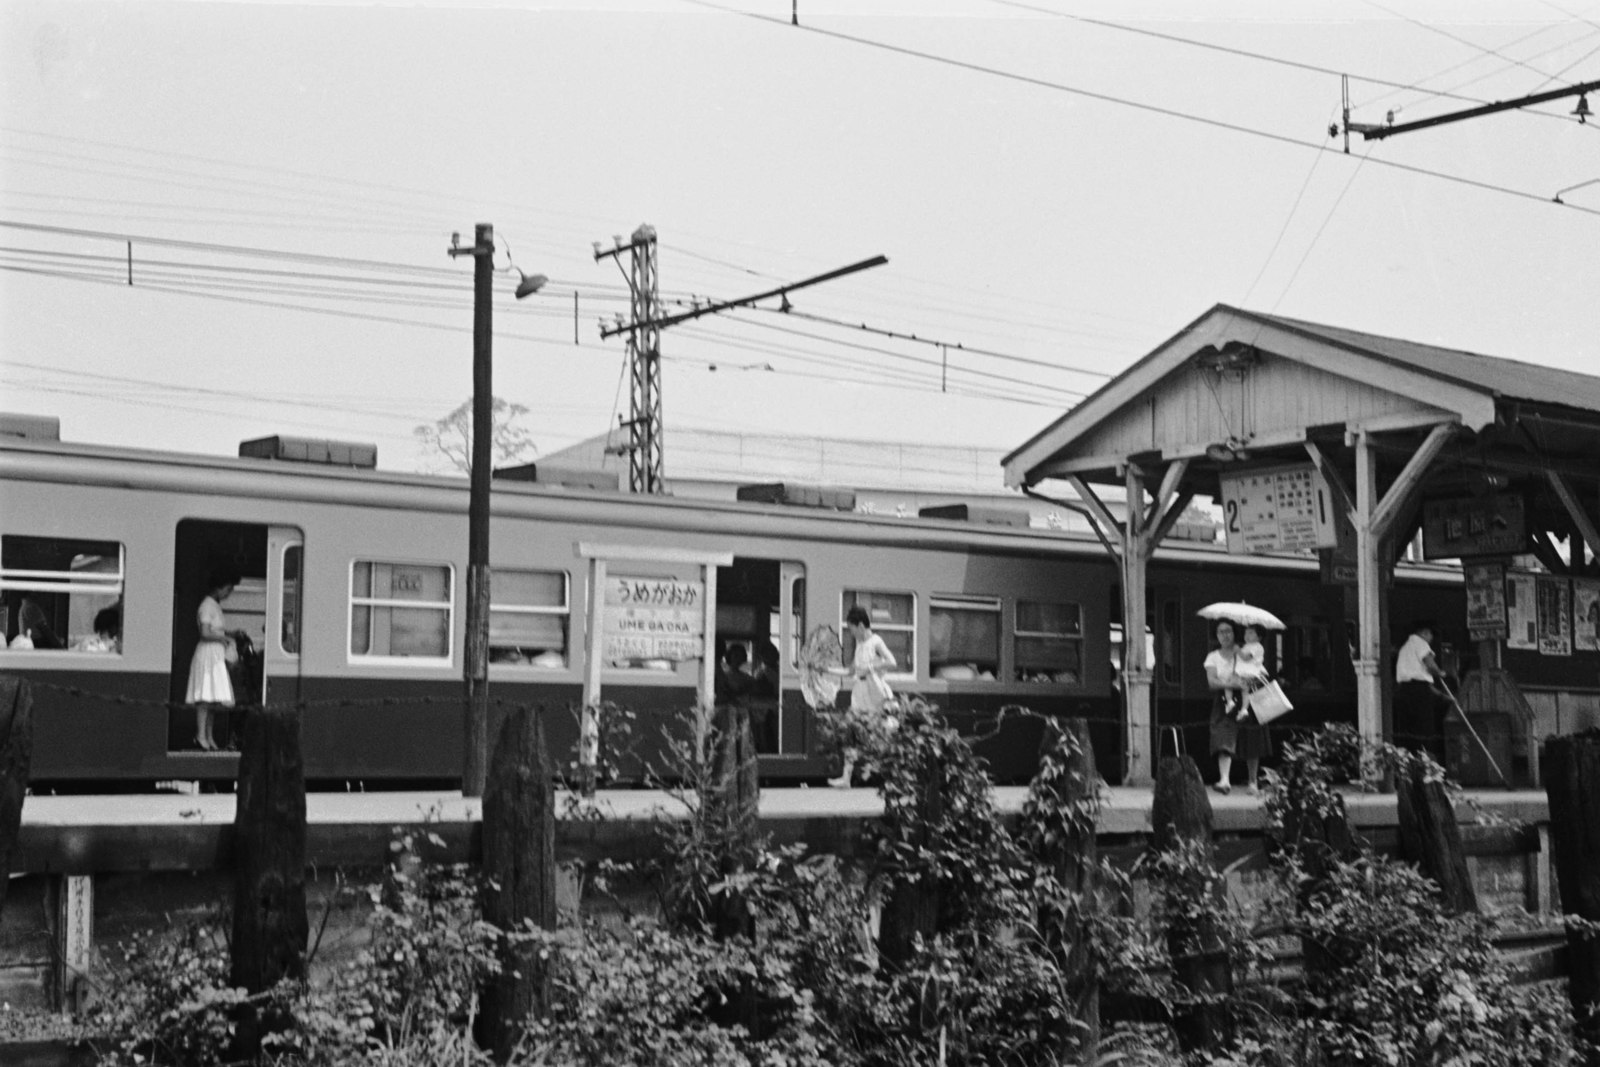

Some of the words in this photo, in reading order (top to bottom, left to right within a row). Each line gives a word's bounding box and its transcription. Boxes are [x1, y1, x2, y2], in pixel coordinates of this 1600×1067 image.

[1227, 499, 1240, 533] 2
[1318, 488, 1326, 525] 1
[618, 580, 697, 606] うめがおか
